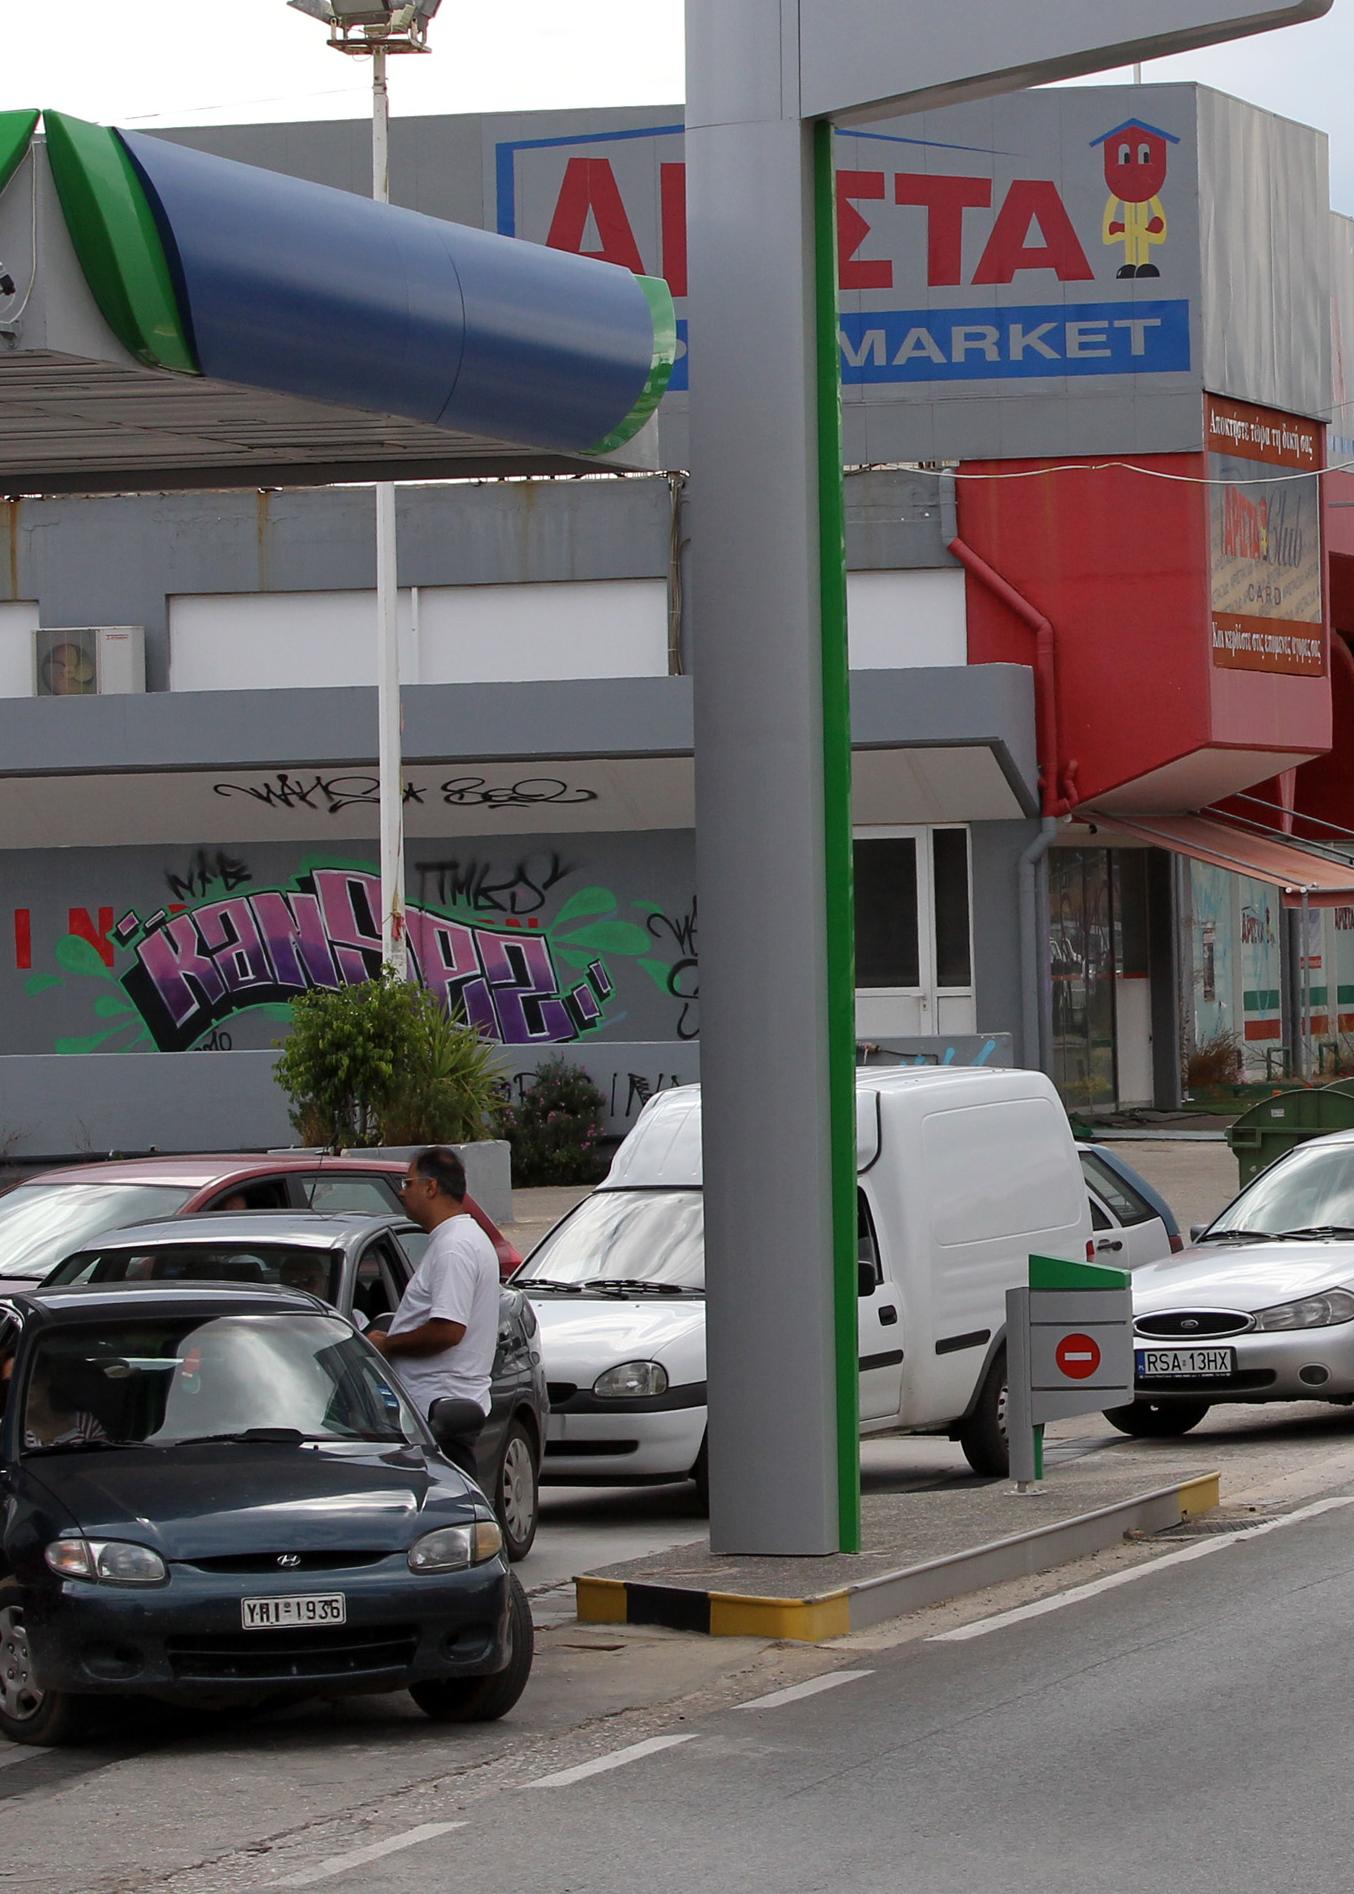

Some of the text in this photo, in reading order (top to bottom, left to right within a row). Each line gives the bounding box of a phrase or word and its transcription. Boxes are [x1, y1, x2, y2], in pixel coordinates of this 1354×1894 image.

[545, 157, 1095, 298] ΑΣΤΑ
[838, 318, 1162, 367] MARKET
[1147, 1351, 1228, 1372] RSA 13HX
